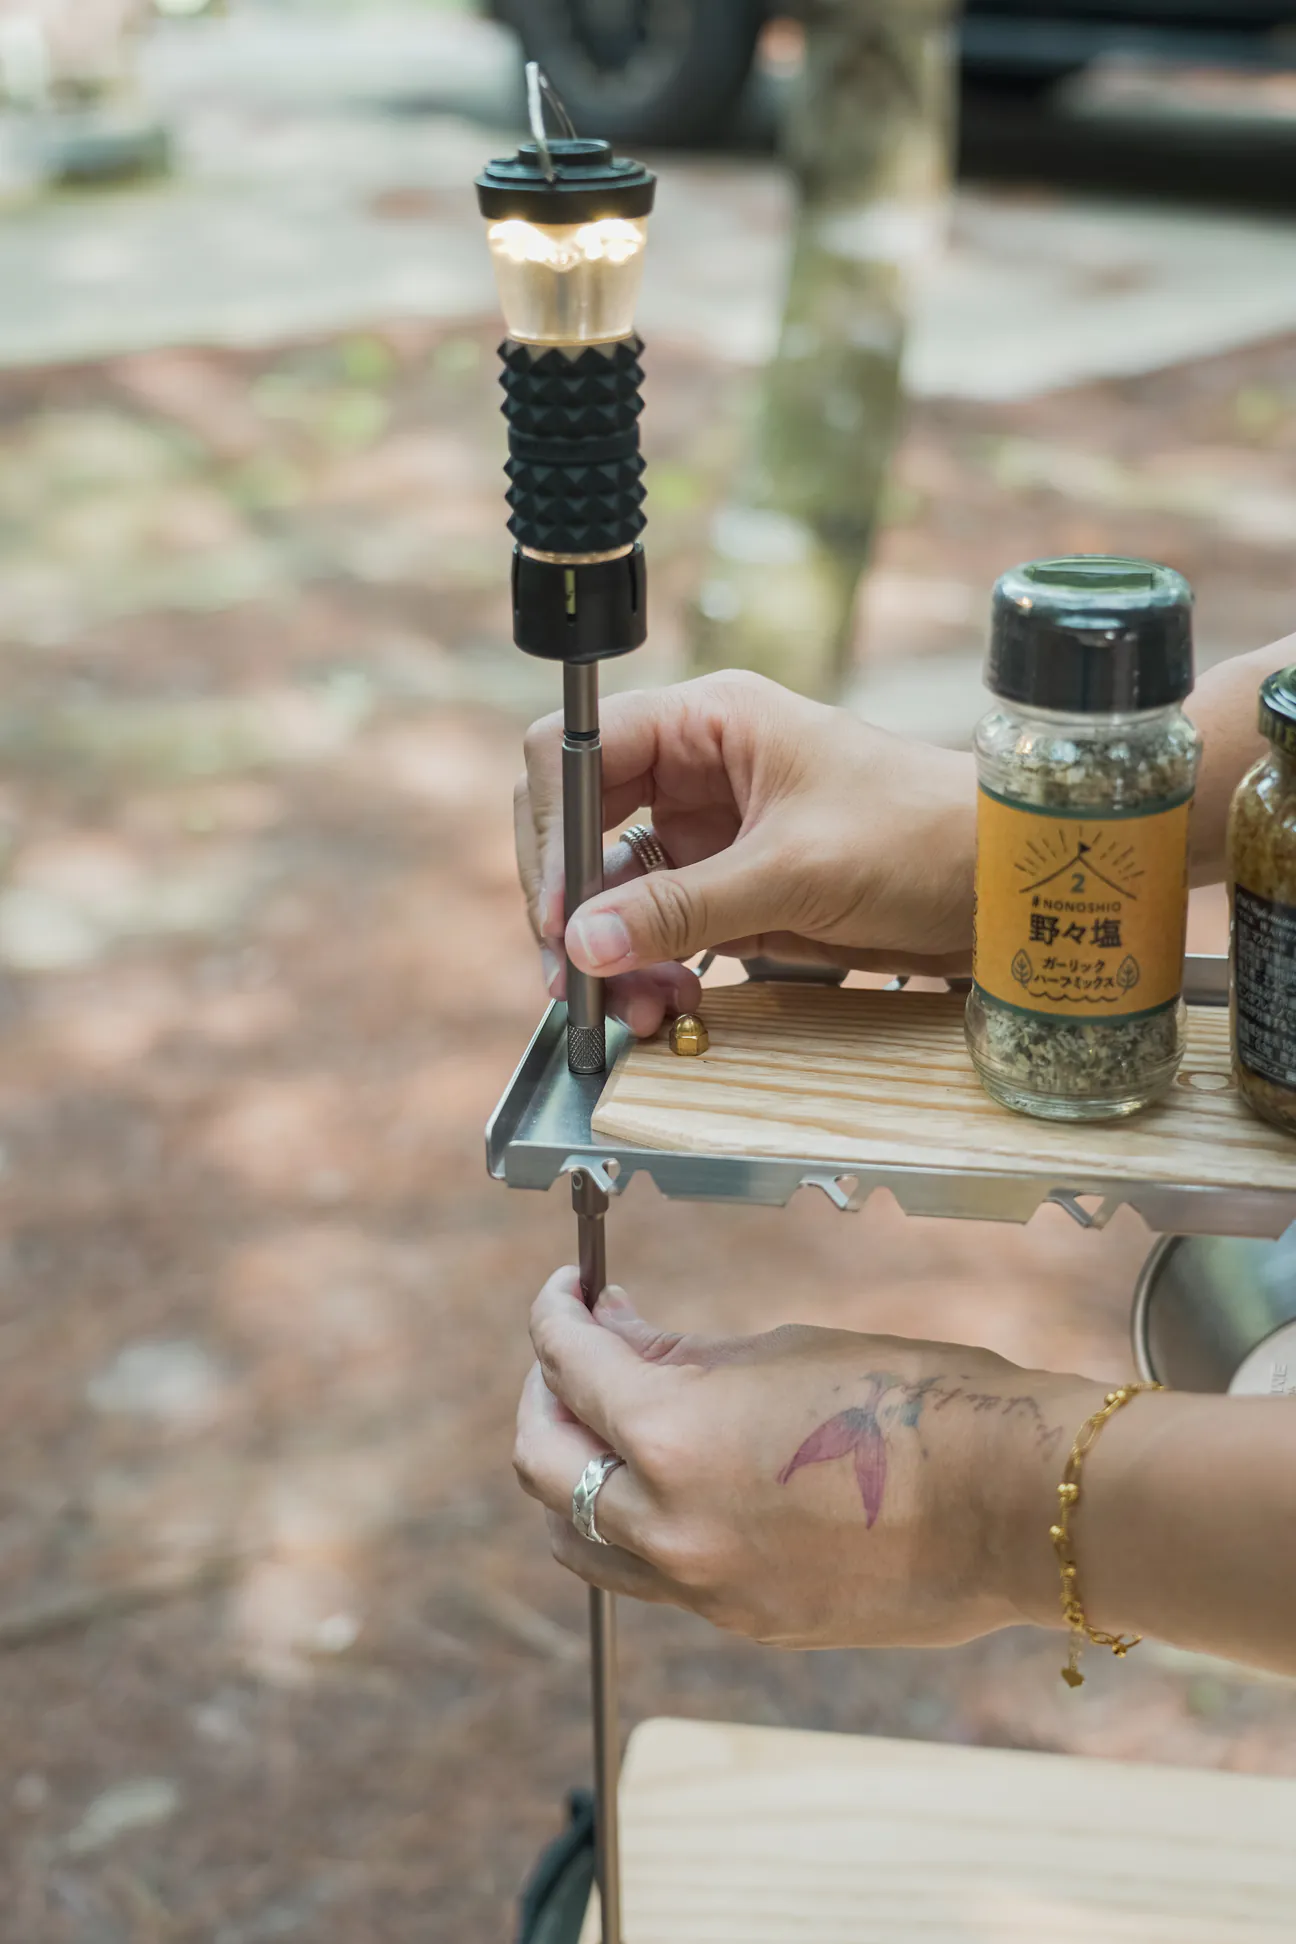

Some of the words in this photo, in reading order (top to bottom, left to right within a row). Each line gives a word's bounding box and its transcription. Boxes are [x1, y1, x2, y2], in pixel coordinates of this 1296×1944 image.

[1070, 872, 1086, 894] 2
[1031, 895, 1122, 913] #NONOSHIO
[1029, 913, 1122, 948] 野々塩
[1042, 956, 1105, 973] ガーリック
